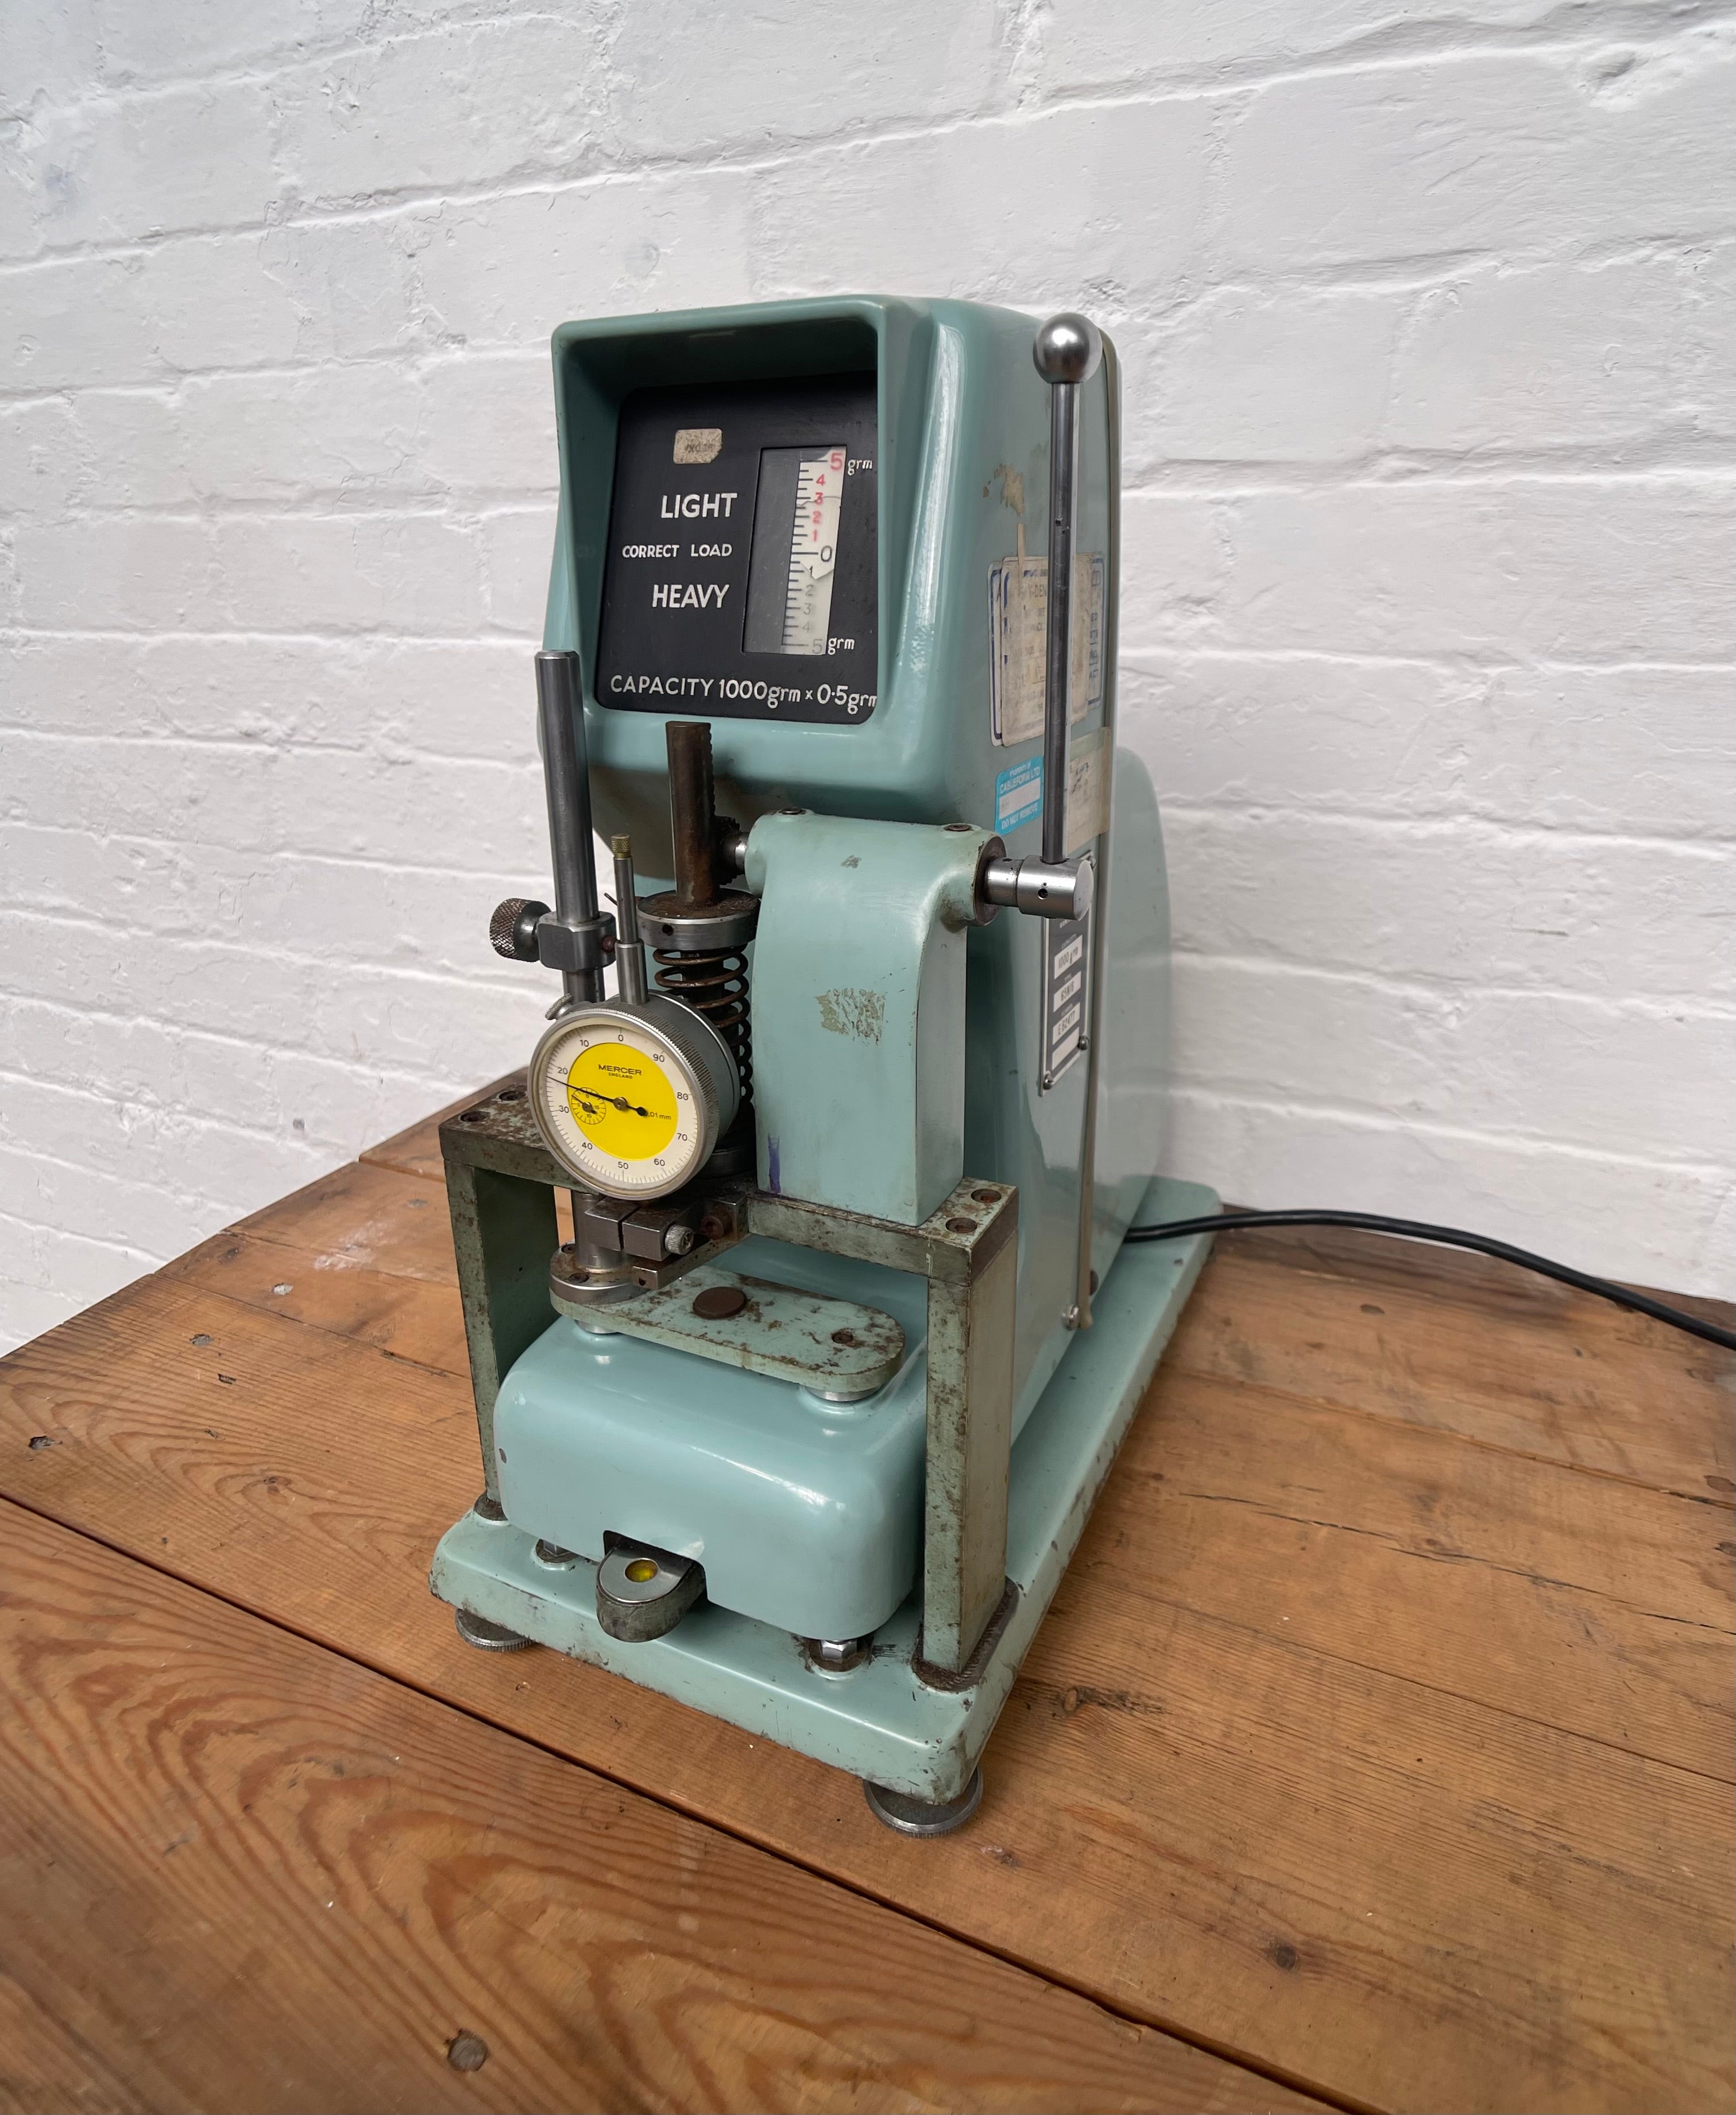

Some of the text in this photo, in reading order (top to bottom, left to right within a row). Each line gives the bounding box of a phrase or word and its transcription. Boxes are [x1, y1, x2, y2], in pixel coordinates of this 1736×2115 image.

[830, 452, 872, 475] 5 grm
[816, 474, 826, 486] 4
[815, 492, 823, 505] 3
[661, 493, 737, 518] LIGHT
[813, 511, 822, 524] 2
[813, 529, 818, 542] 1
[622, 543, 732, 558] CORRECT LOAD
[821, 546, 833, 562] 0
[809, 566, 813, 577] 1
[652, 584, 729, 608] HEAVY
[805, 584, 814, 597] 2
[803, 602, 811, 615] 3
[802, 621, 810, 632] 4
[812, 637, 855, 655] 5 grm
[610, 675, 714, 697] CAPACITY
[719, 679, 801, 709] 1000grm
[653, 1054, 665, 1062] 90
[558, 1067, 568, 1075] 20
[598, 1064, 642, 1076] MERCER
[677, 1092, 689, 1100] 80
[677, 1133, 687, 1142] 70
[618, 1162, 628, 1170] 50
[654, 1158, 665, 1166] 60
